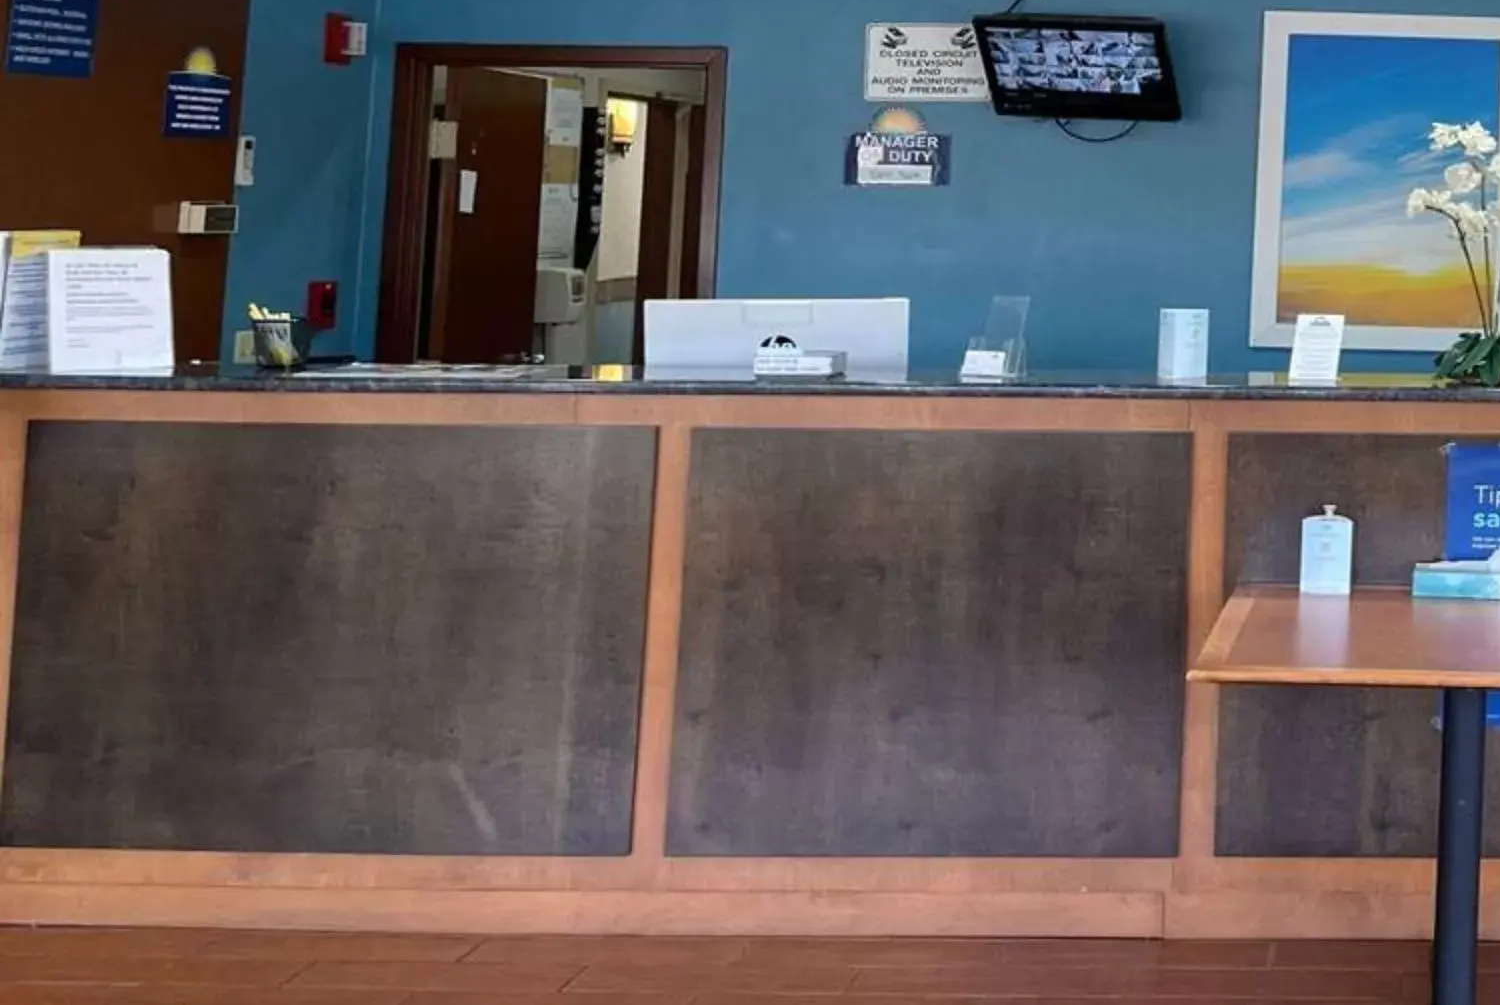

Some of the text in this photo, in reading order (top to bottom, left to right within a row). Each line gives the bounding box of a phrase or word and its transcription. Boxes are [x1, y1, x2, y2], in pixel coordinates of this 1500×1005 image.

[879, 49, 929, 58] CLOSED
[896, 58, 963, 68] TELEVISION
[916, 68, 941, 76] AND
[871, 76, 986, 85] AUDIO MONITORING
[887, 86, 905, 94] ON
[855, 134, 939, 148] MANAGER
[888, 150, 933, 163] DUTY
